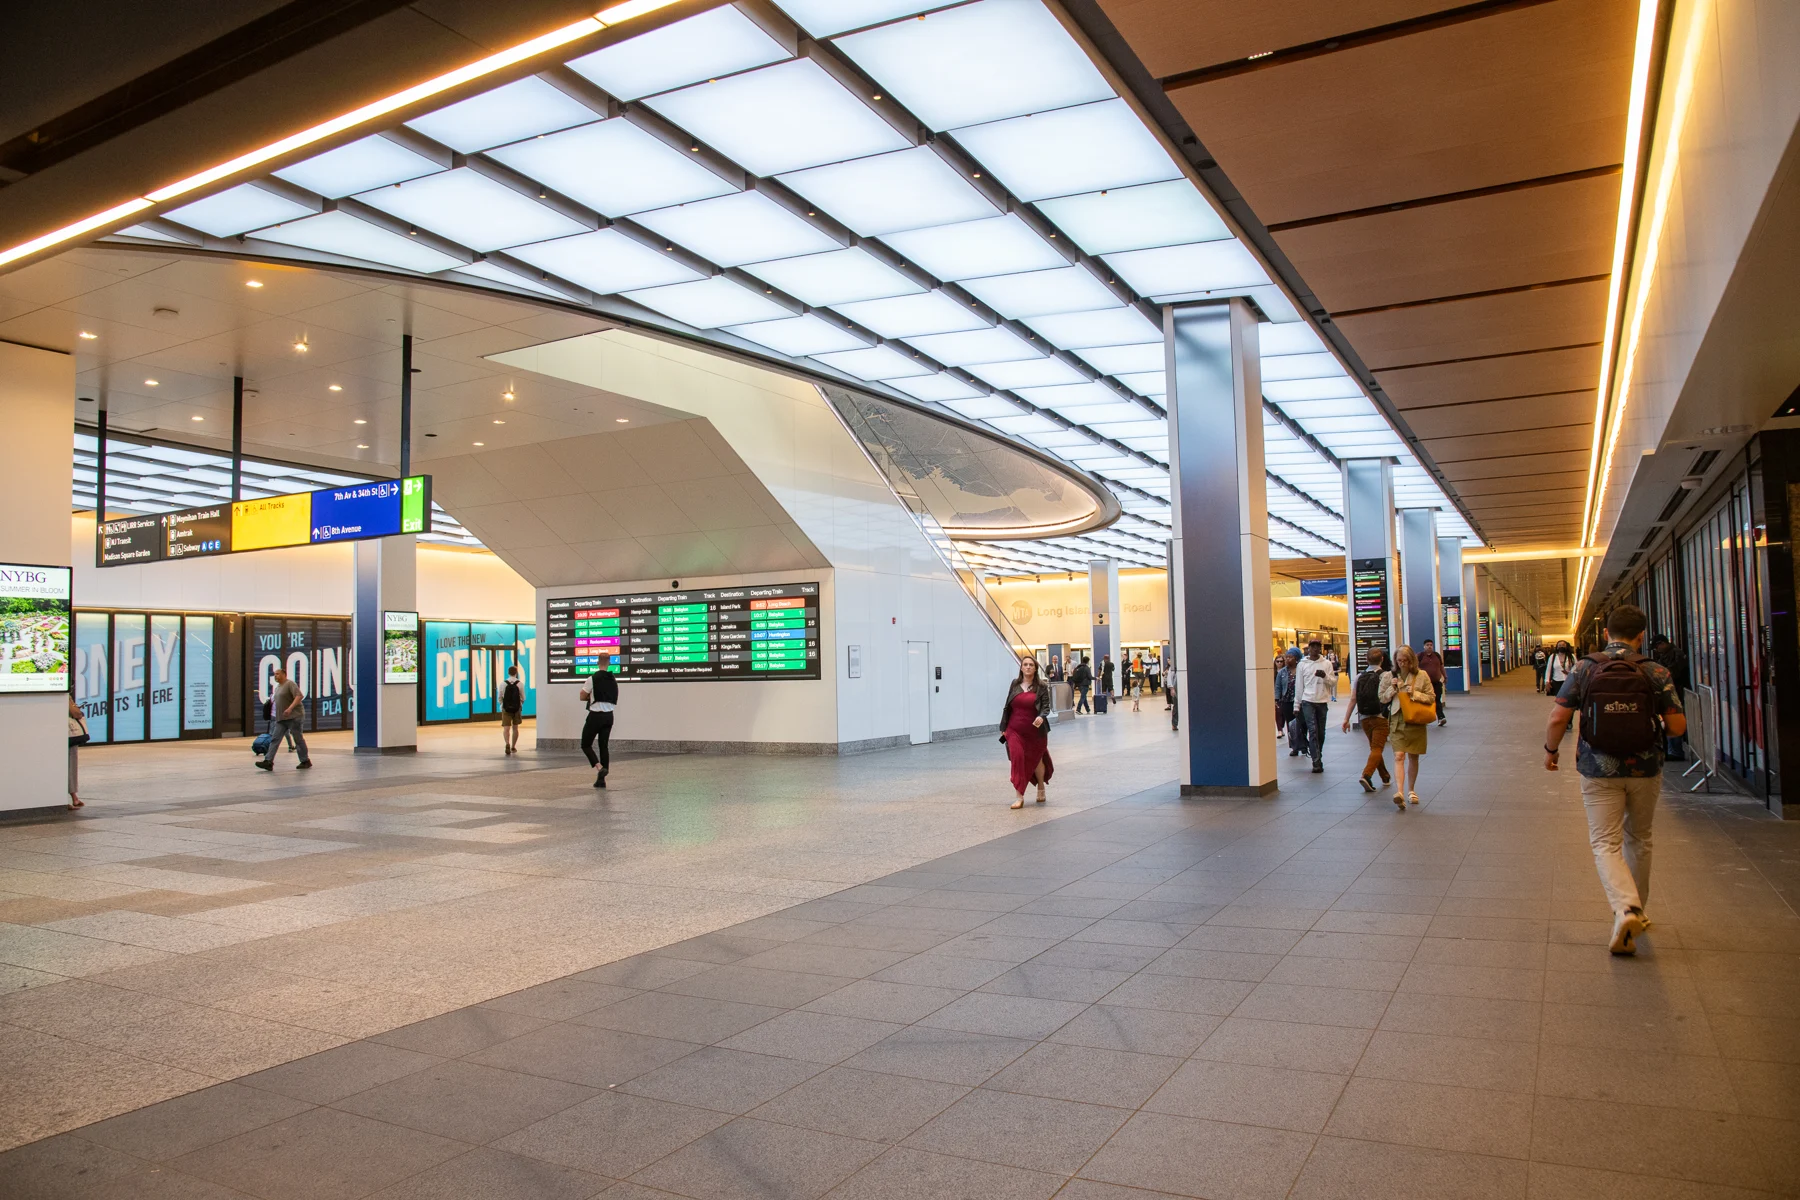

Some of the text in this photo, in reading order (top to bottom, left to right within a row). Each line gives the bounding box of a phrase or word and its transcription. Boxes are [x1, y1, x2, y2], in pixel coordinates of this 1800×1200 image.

[335, 493, 344, 501] 7th
[358, 490, 370, 498] 34th
[371, 488, 378, 496] St
[198, 512, 209, 520] Train
[331, 525, 362, 535] 8th Avenue
[403, 518, 422, 531] Exit
[176, 529, 193, 538] Amtrak
[183, 544, 200, 552] Subway
[121, 552, 135, 560] Square
[0, 570, 47, 583] NYBG
[1038, 608, 1062, 617] Long
[1124, 602, 1152, 612] Road
[440, 637, 456, 648] LOVE
[458, 636, 470, 646] THE
[472, 634, 486, 644] NEW
[436, 644, 505, 708] PENN
[137, 688, 173, 708] HERE
